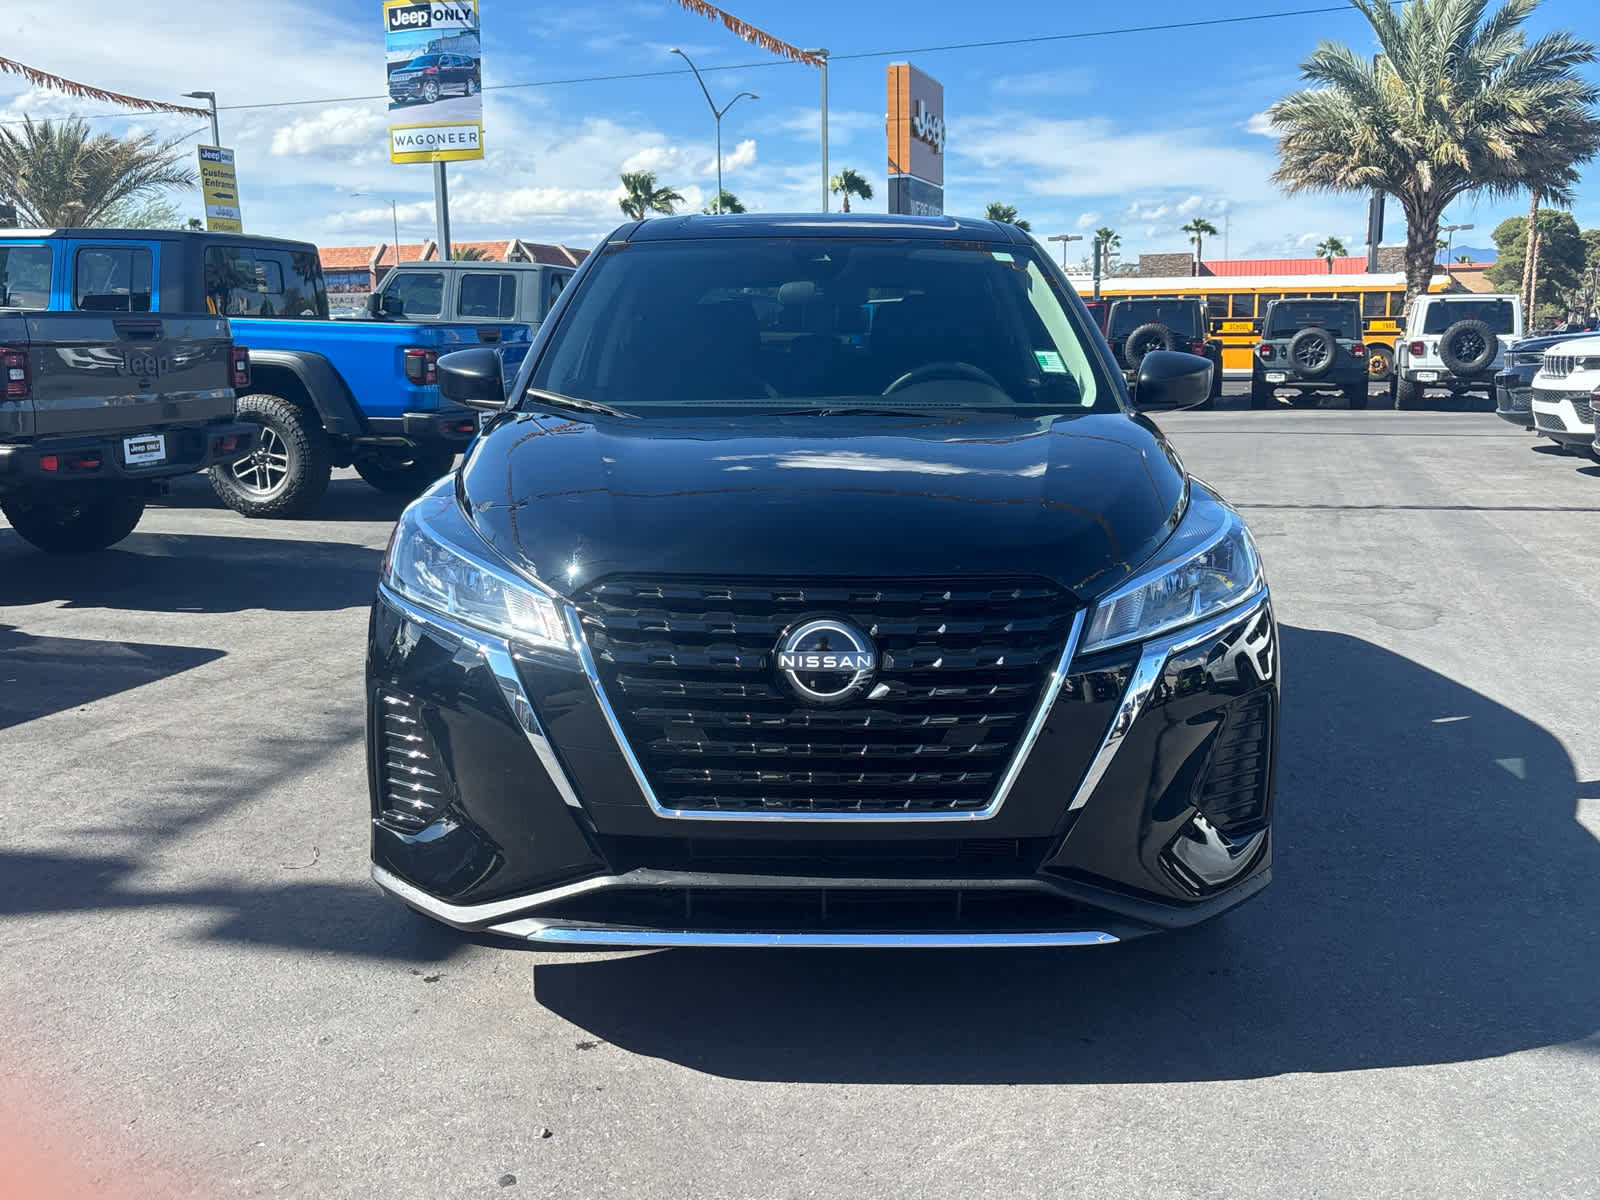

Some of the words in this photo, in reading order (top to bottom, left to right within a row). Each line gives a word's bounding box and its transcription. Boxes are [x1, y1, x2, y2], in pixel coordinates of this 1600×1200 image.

[391, 9, 429, 27] Jeep
[433, 8, 472, 21] ONLY
[914, 98, 946, 153] Jeep
[394, 131, 478, 146] WAGONEER
[201, 149, 220, 161] Jeep
[115, 351, 169, 380] Jeep
[780, 655, 871, 668] NISSAN
